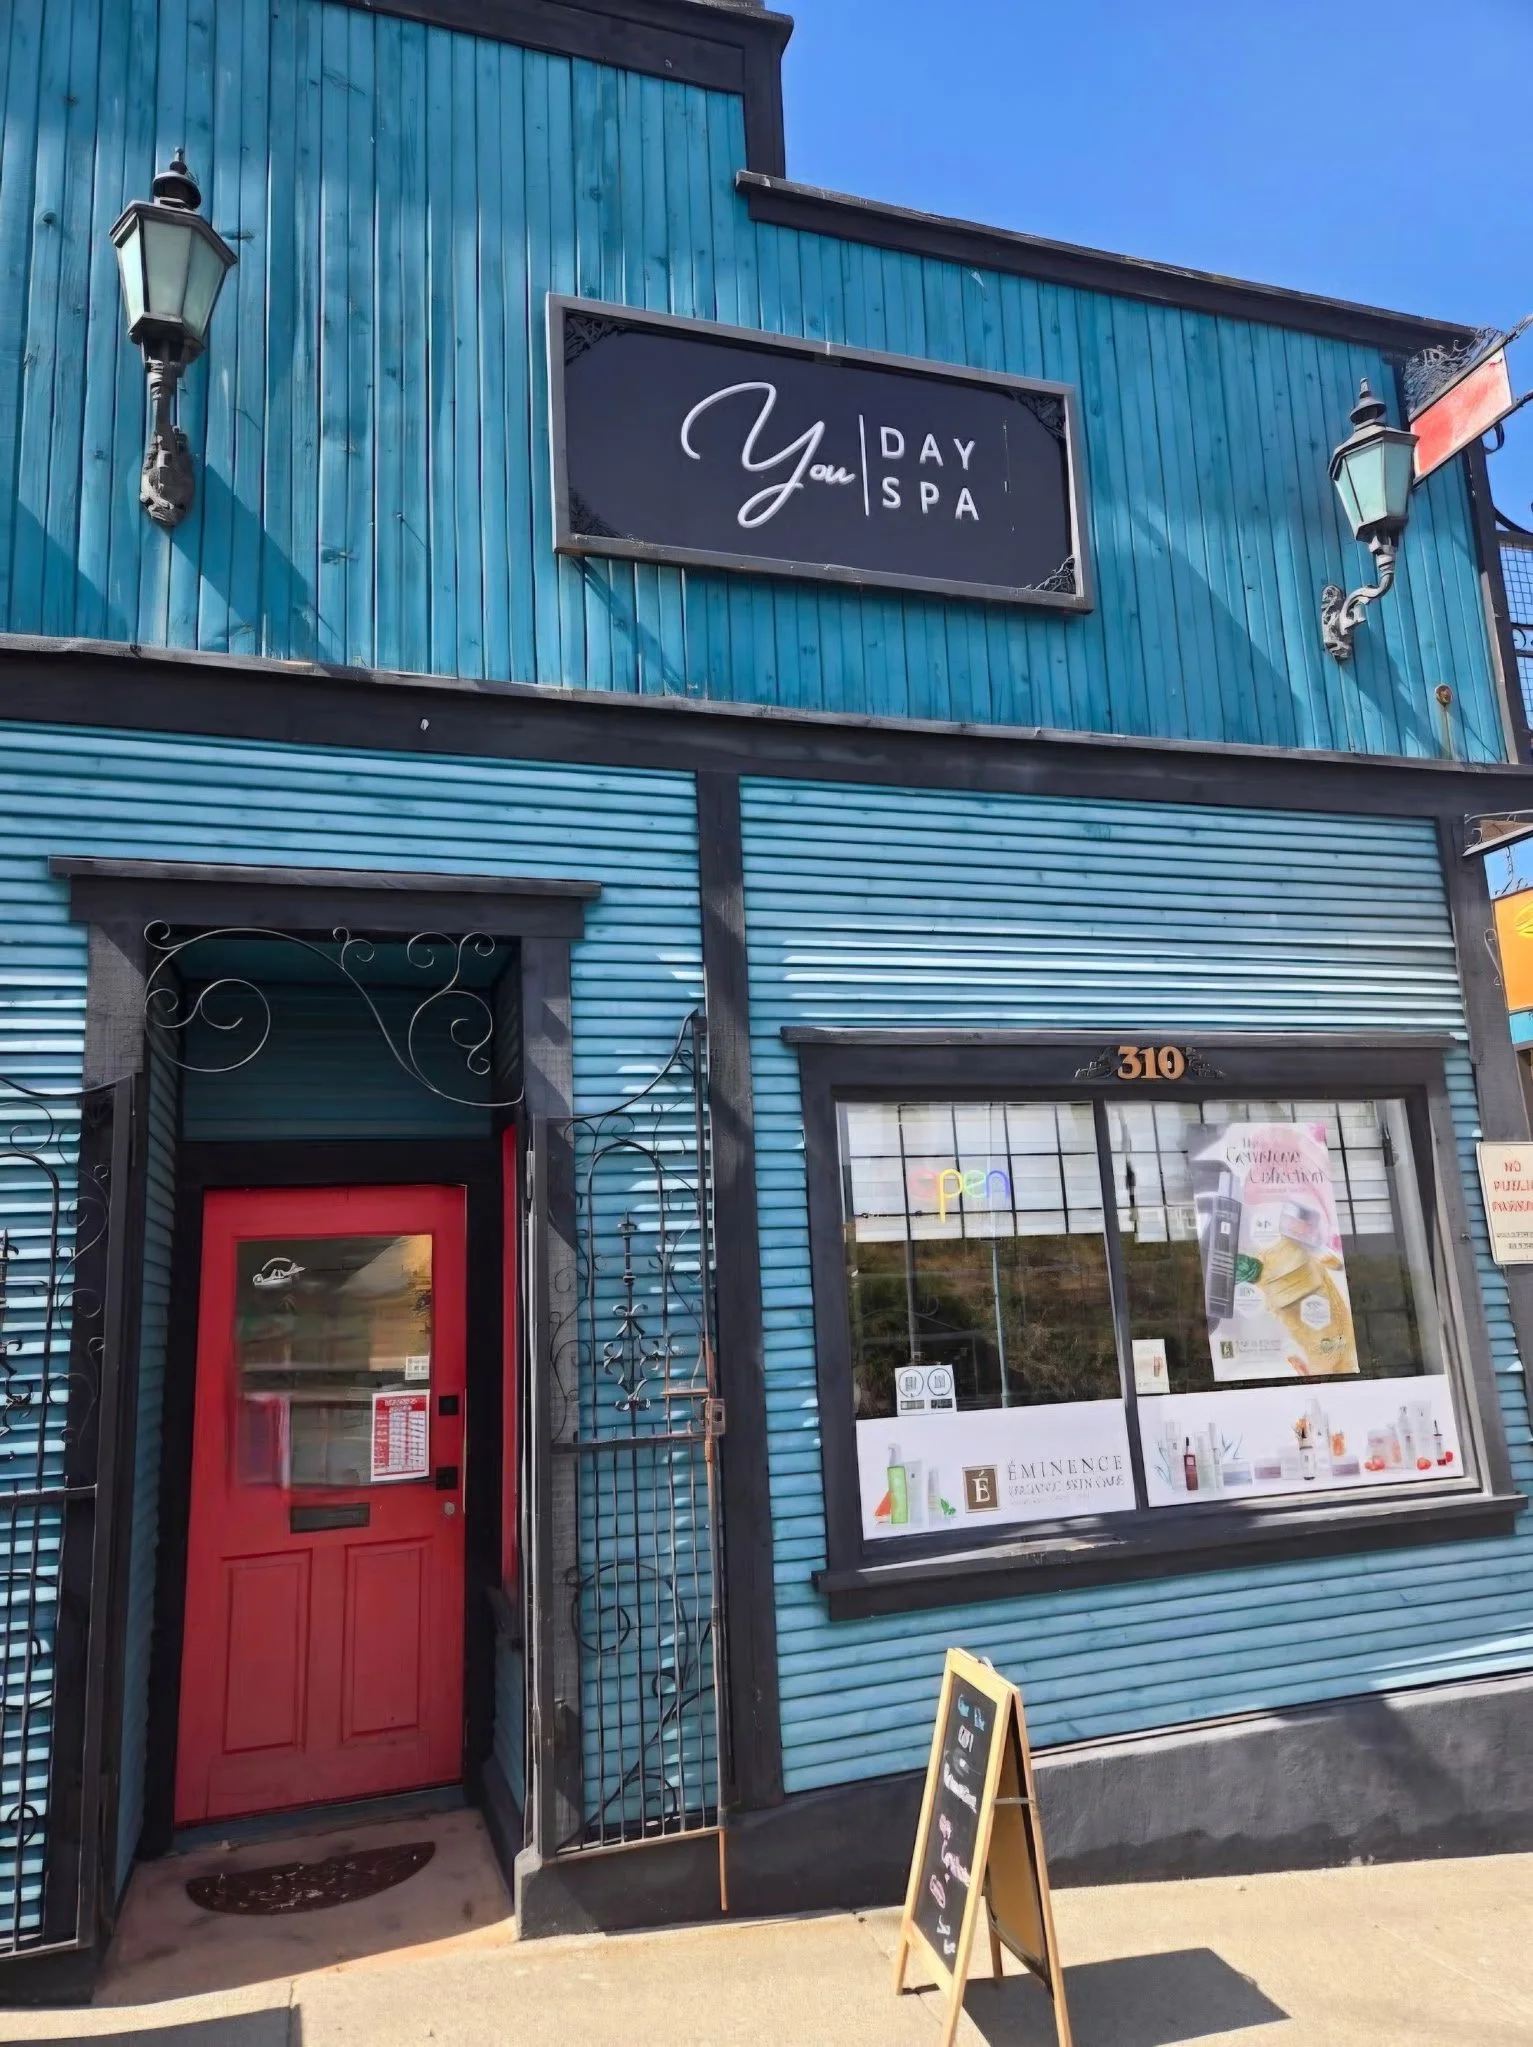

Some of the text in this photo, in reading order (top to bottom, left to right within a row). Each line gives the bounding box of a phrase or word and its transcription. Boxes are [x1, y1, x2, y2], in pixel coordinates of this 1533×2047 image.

[681, 381, 855, 528] You
[880, 426, 975, 470] DAY
[882, 476, 979, 521] SPA
[1117, 1045, 1185, 1080] 310
[1007, 1454, 1123, 1481] ÉMINENCE
